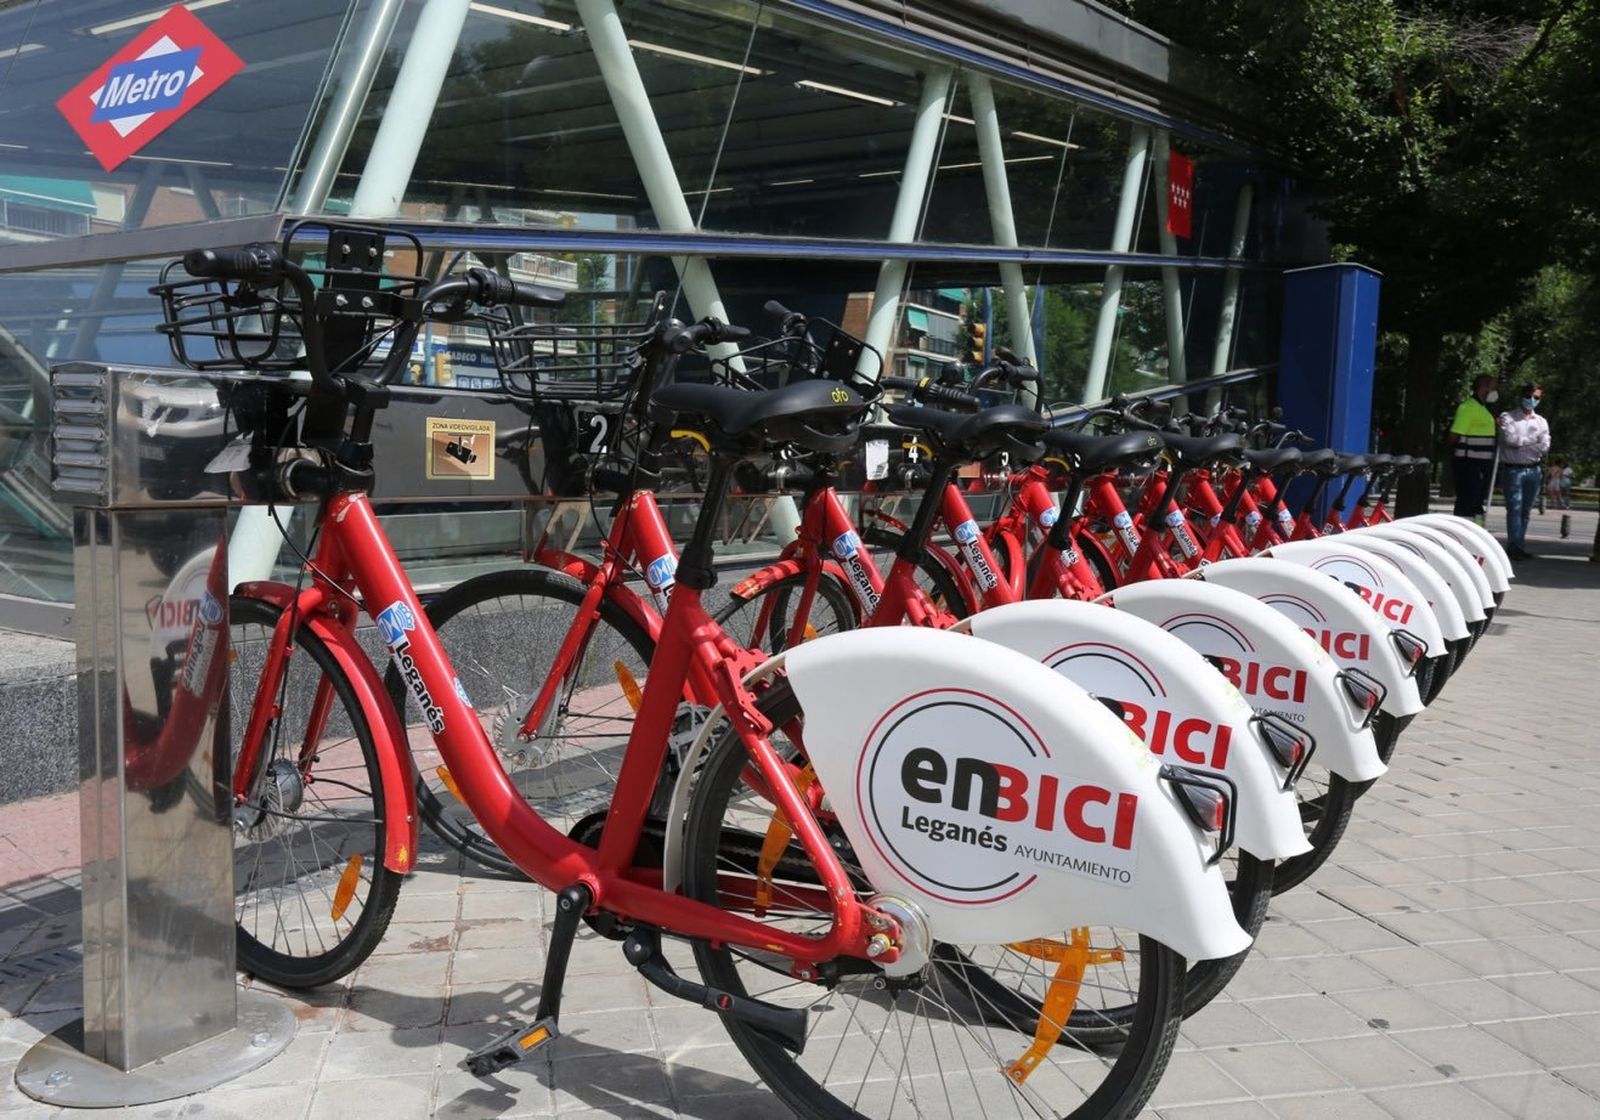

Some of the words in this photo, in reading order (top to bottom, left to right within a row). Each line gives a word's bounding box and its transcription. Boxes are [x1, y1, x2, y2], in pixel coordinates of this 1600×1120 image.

[101, 70, 186, 109] Metro
[590, 415, 608, 453] 2
[908, 436, 919, 464] 4
[848, 554, 882, 608] Legané
[968, 539, 999, 588] Leganés
[395, 641, 444, 733] Leganés
[1097, 696, 1232, 770] BICI
[900, 746, 1139, 850] enBICI
[901, 805, 1008, 852] Leganés
[1014, 844, 1132, 884] AYUNTAMIENTO
